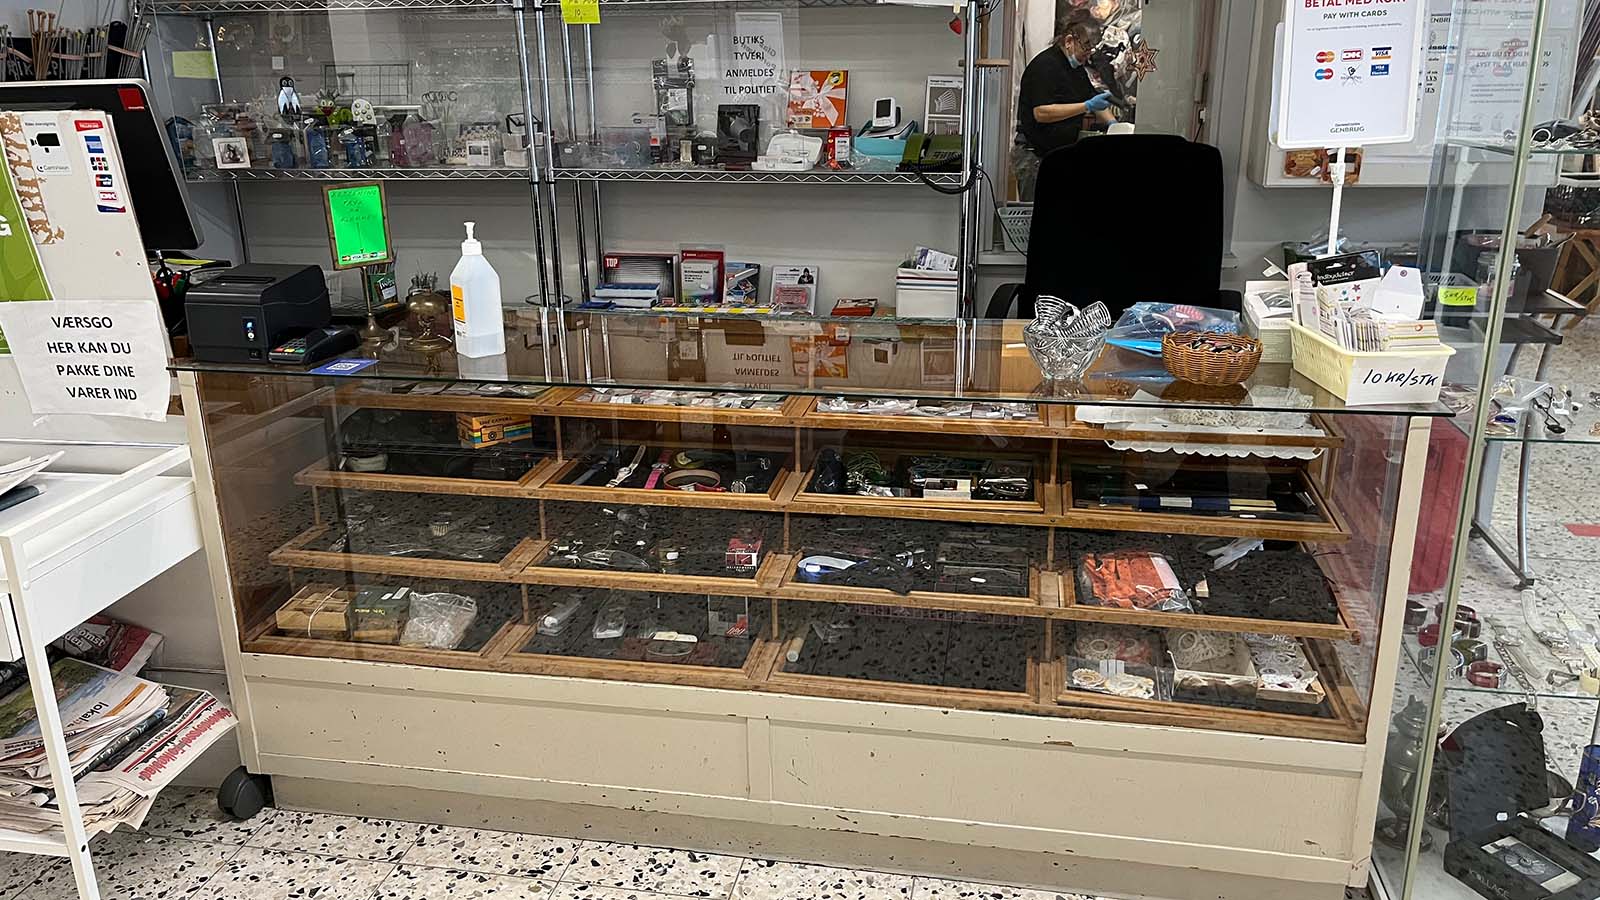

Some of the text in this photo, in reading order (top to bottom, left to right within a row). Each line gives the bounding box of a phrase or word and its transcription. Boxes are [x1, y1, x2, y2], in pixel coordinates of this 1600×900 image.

[1361, 9, 1388, 17] CARDS
[733, 35, 765, 46] BUTIKS
[734, 52, 765, 61] TYVERI
[726, 68, 775, 78] ANMELDES
[724, 85, 777, 95] TIL POLITIET
[1329, 126, 1365, 134] GENBRUG
[606, 258, 618, 268] TOP
[51, 316, 113, 329] VÆRSGO
[46, 342, 131, 355] HER KAN DU
[56, 364, 136, 378] PAKKE DINE
[66, 387, 137, 400] VARER IND
